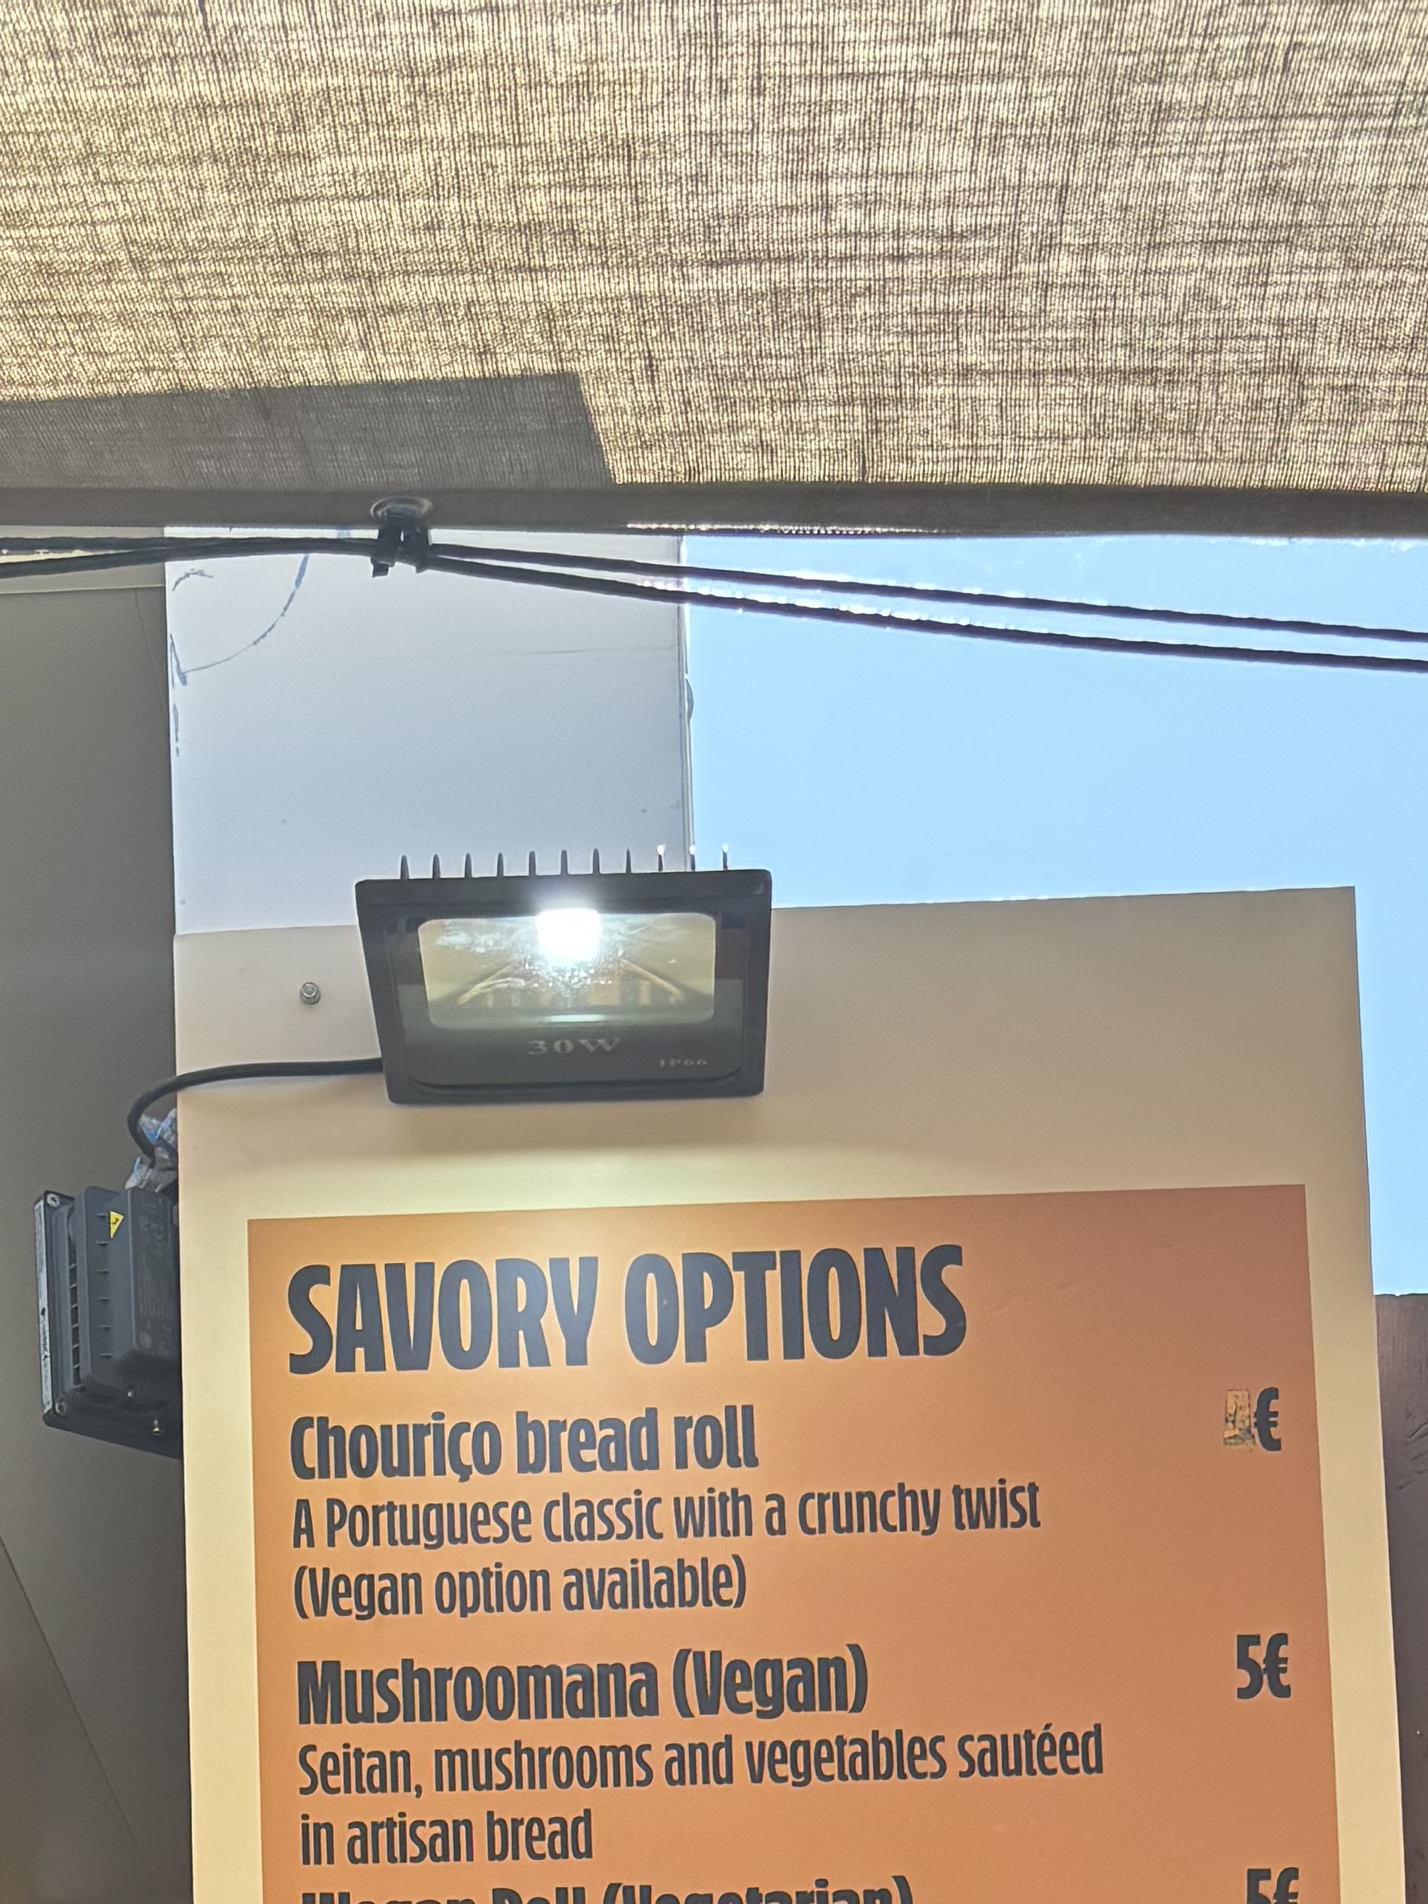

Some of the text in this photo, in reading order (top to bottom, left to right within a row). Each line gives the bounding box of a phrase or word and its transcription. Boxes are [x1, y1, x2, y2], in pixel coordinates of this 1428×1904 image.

[287, 1257, 598, 1376] SAVORY
[625, 1244, 967, 1365] OPTIONS
[289, 1403, 760, 1484] Chouriço bread roll
[292, 1477, 1042, 1551] A Portuguese classic with a crunchy twist
[293, 1553, 747, 1622] (Vegan option available)
[296, 1643, 869, 1726] Mushroomana (Vegan)
[1236, 1632, 1292, 1700] 5€
[298, 1722, 1104, 1799] Seitan, mushrooms and vegetables sautéed
[300, 1807, 593, 1866] in artisan bread
